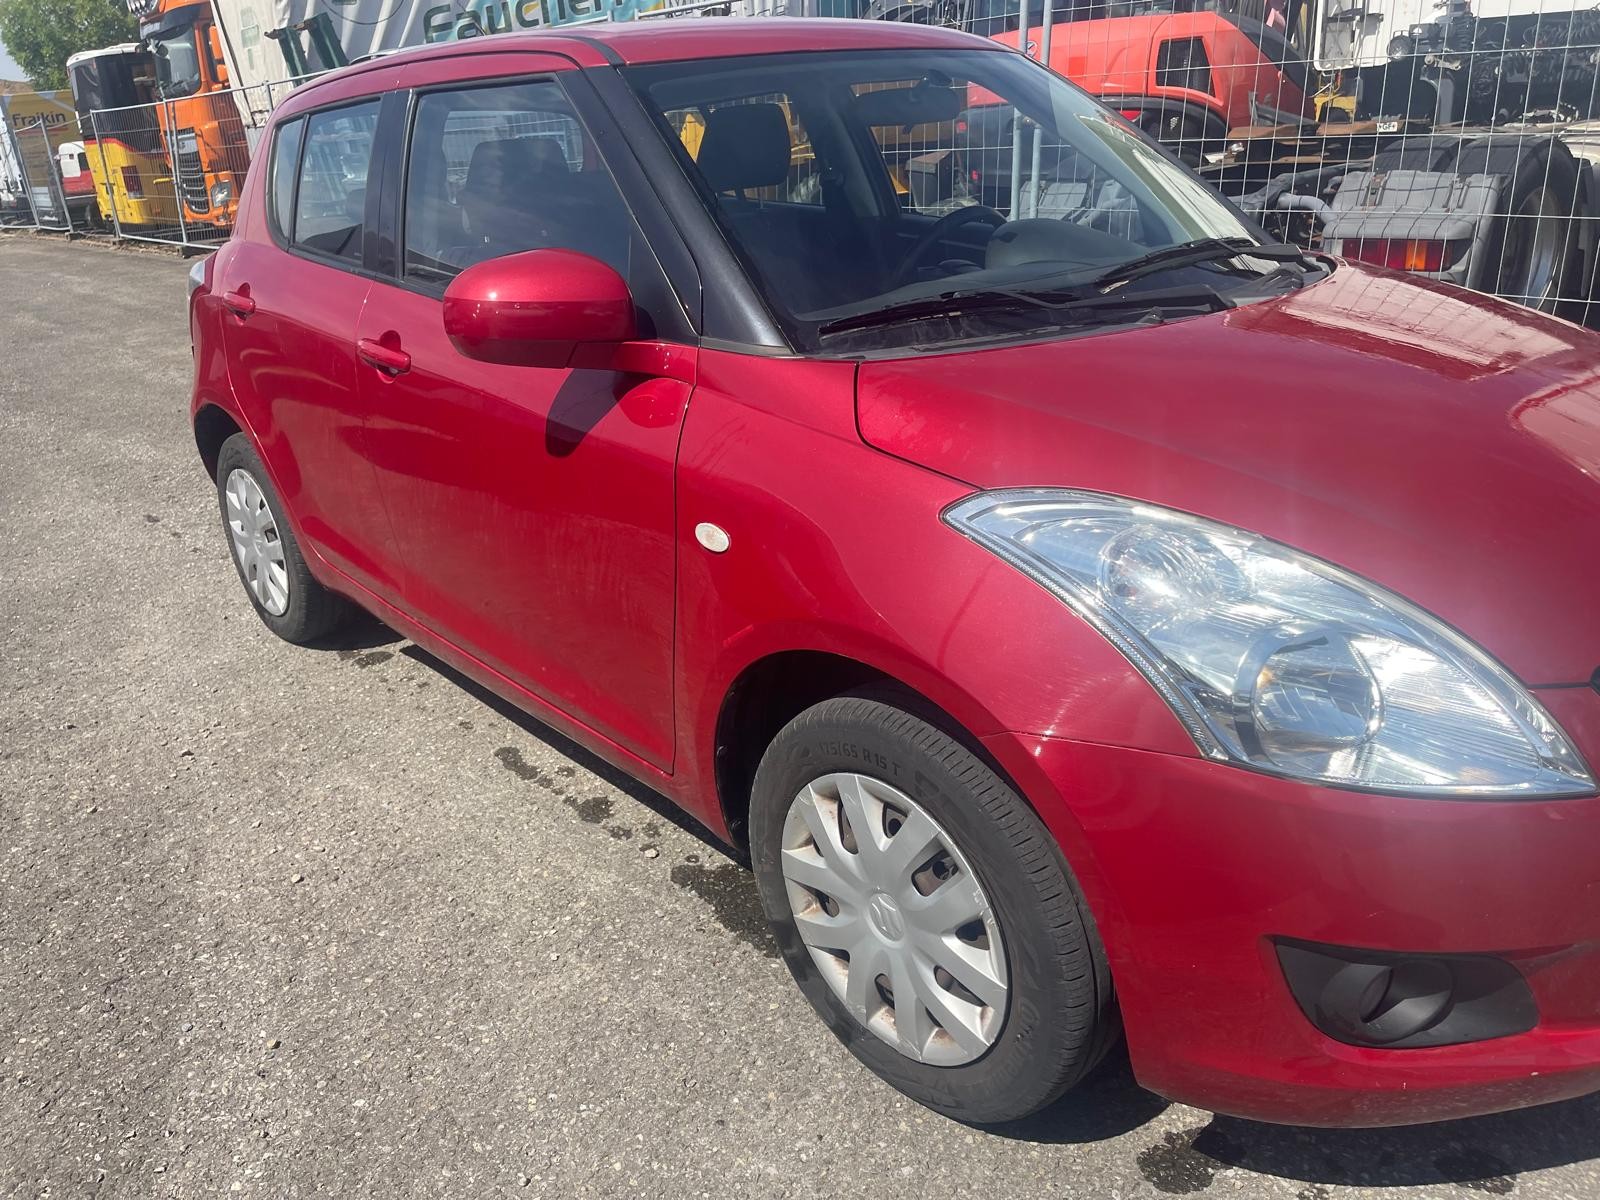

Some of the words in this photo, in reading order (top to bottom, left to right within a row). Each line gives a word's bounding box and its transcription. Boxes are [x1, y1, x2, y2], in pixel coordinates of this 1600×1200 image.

[12, 111, 66, 127] Fraikin
[862, 750, 872, 763] R
[875, 753, 888, 769] 15
[892, 762, 901, 776] T
